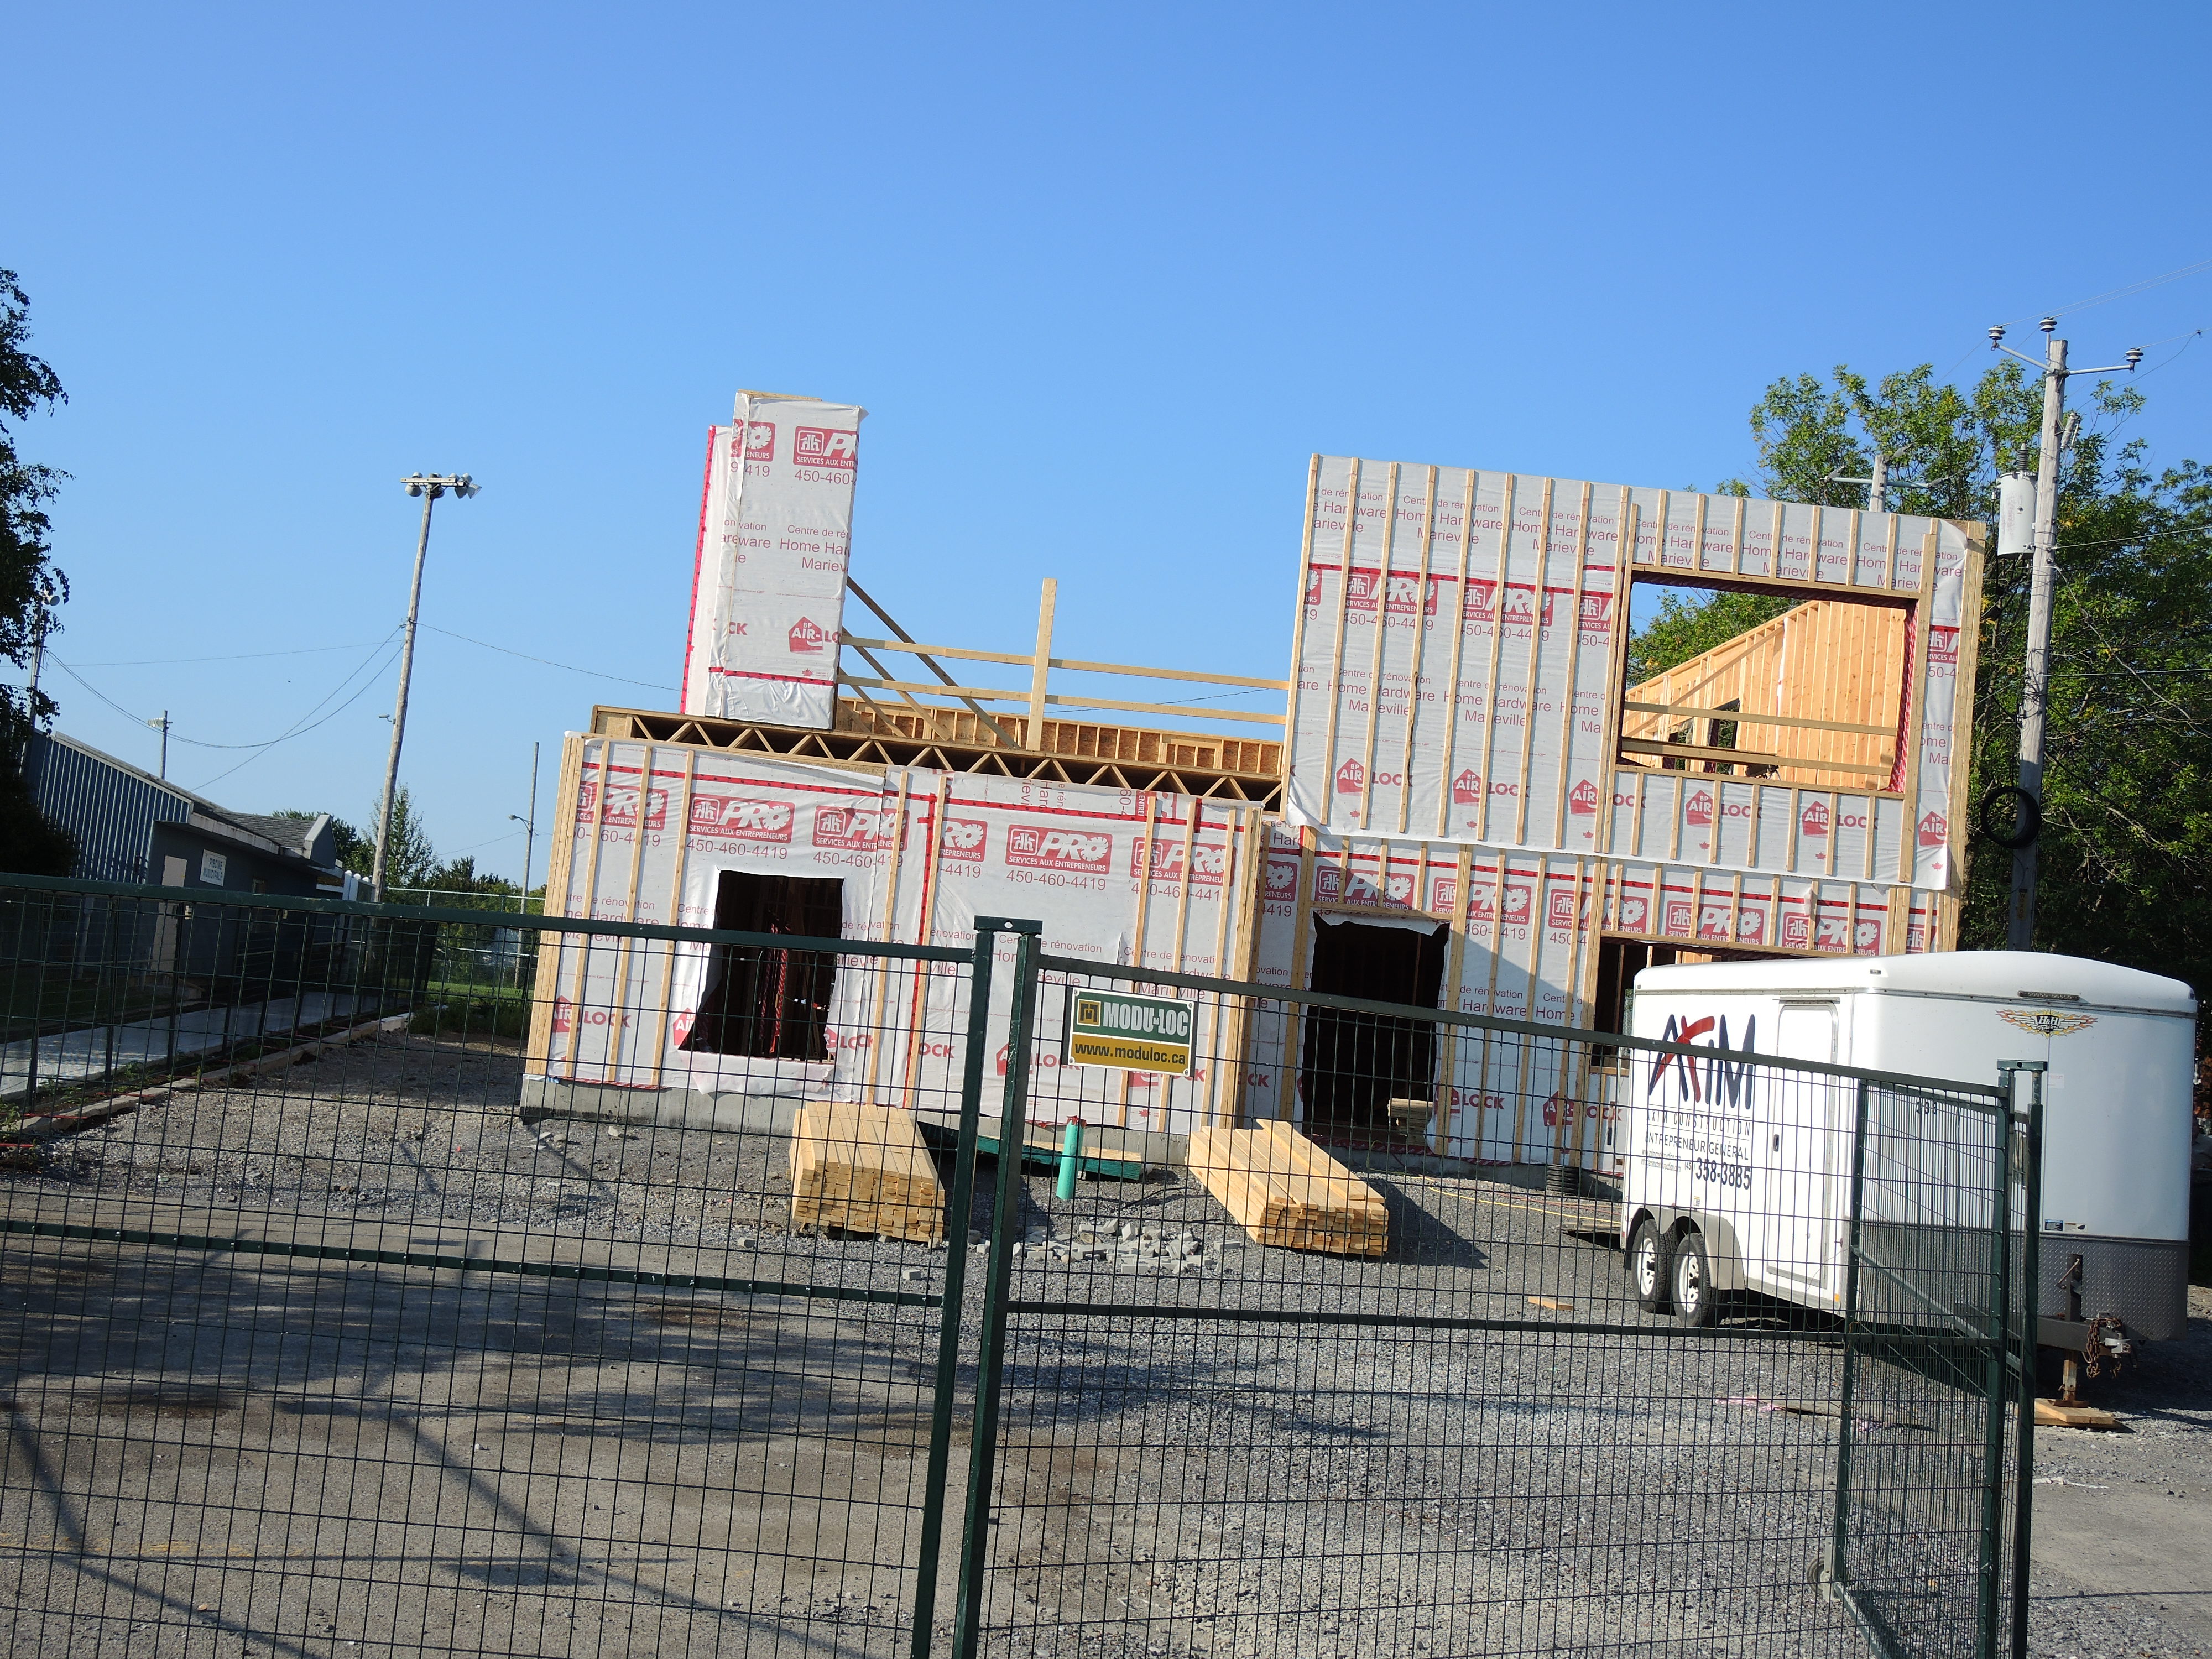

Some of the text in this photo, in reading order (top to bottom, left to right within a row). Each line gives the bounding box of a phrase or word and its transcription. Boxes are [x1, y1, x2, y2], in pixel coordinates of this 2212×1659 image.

[797, 456, 823, 465] SERVICES
[1321, 488, 1383, 501] de rénvation
[1324, 501, 1386, 518] Harware
[1451, 500, 1499, 513] rénvation
[1439, 513, 1503, 530] Harware
[1567, 512, 1614, 525] rénvation
[787, 525, 819, 536] Centre
[822, 528, 834, 537] de
[1555, 524, 1618, 541] Harware
[1667, 523, 1729, 536] de rénvation
[780, 538, 820, 552] Home
[1671, 536, 1733, 553] Harware
[1782, 535, 1843, 549] de rénvation
[1785, 548, 1848, 565] Harware
[1339, 769, 1363, 781] AIR
[1455, 780, 1479, 791] AIR
[1688, 801, 1712, 812] AIR
[718, 801, 791, 831] PRO
[1804, 812, 1828, 823] AIR
[689, 825, 718, 834] SERVICES
[736, 830, 787, 841] ENTREPRENEURS
[686, 839, 787, 859] 450-460-4419
[816, 837, 844, 847] SERVICES
[1036, 832, 1108, 862] PRO
[1009, 855, 1037, 865] SERVICES
[1055, 860, 1106, 872] ENTREPRENEURS
[1006, 869, 1106, 890] 450-460-4419
[842, 920, 853, 929] de
[930, 929, 977, 941] énovation
[1051, 940, 1102, 953] rénovation
[1160, 951, 1172, 959] de
[1475, 986, 1523, 999] rénvation
[1463, 999, 1526, 1016] Harware
[1103, 1001, 1188, 1037] MODU-LOC
[2038, 1016, 2059, 1025] H&H
[918, 1042, 954, 1058] OCK
[1075, 1043, 1186, 1065] www.moduloc.ca
[1463, 1093, 1505, 1109] LOCK
[1647, 1110, 1750, 1136] AXIM CONSTRUCTION
[1645, 1131, 1749, 1160] ENTREPRENEUR GÉNÉRAL
[1695, 1157, 1750, 1190] 358-3885
